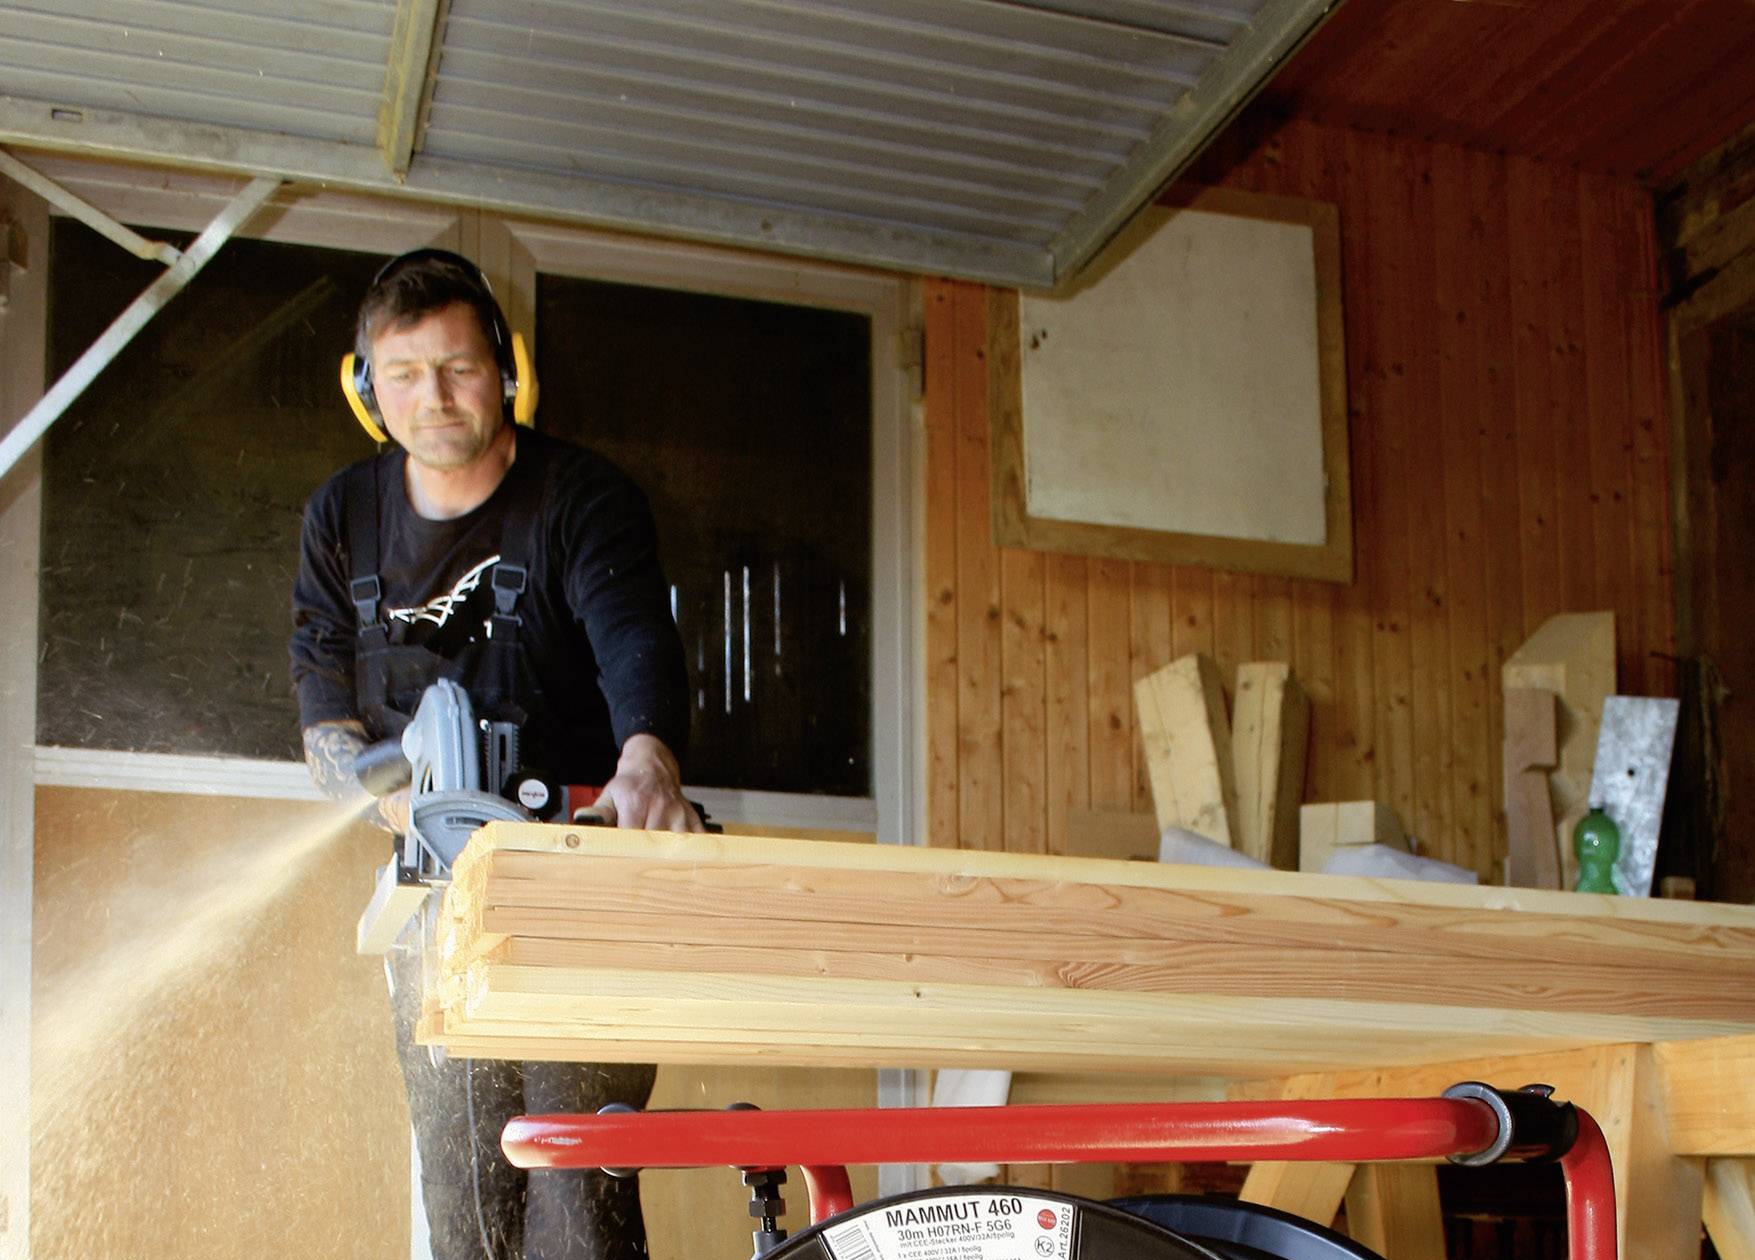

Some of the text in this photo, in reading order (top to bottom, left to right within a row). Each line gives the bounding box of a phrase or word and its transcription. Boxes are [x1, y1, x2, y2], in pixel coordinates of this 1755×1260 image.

[886, 1198, 1022, 1228] MAMMUT 460
[898, 1219, 1012, 1241] 30m H07RN-F 5G6
